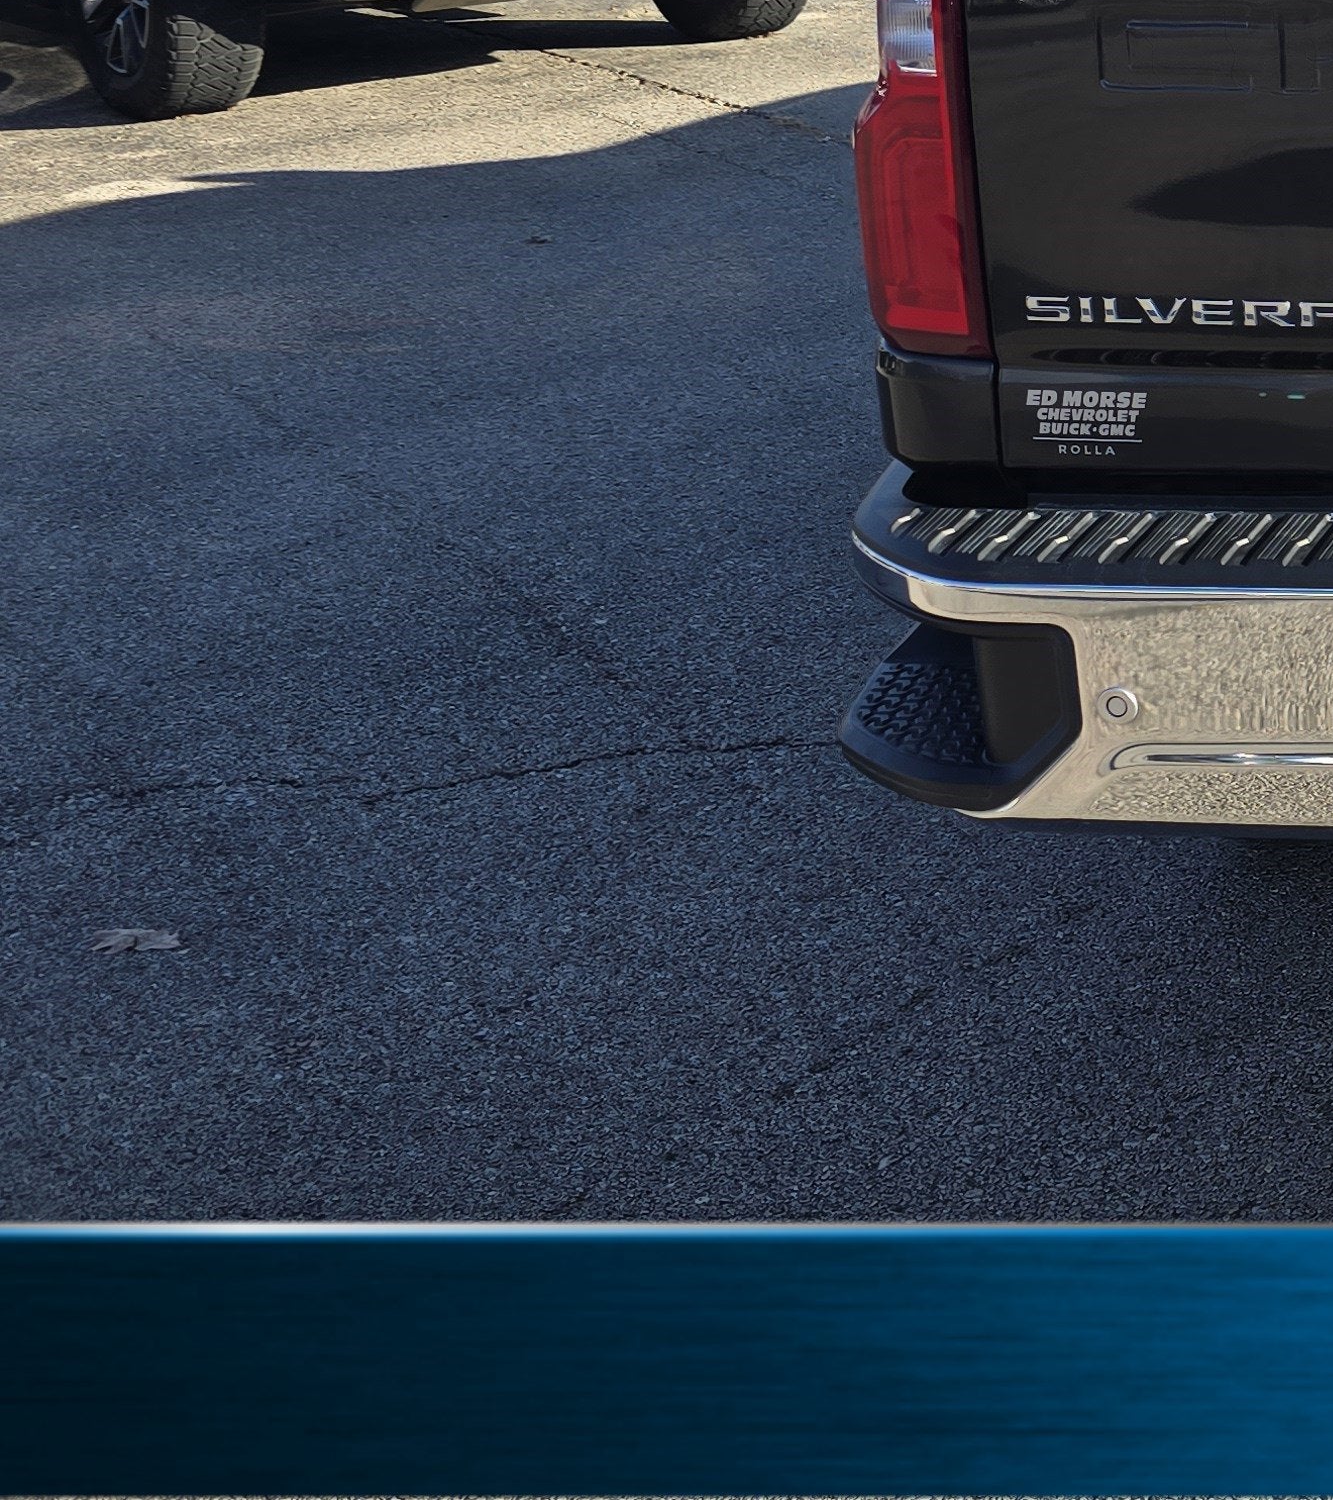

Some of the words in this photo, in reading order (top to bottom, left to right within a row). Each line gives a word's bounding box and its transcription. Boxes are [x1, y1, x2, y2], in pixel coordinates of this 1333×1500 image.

[1026, 389, 1058, 406] ED
[1062, 390, 1148, 409] MORSE
[1037, 407, 1140, 423] CHEVROLET
[1058, 444, 1116, 456] ROLLA
